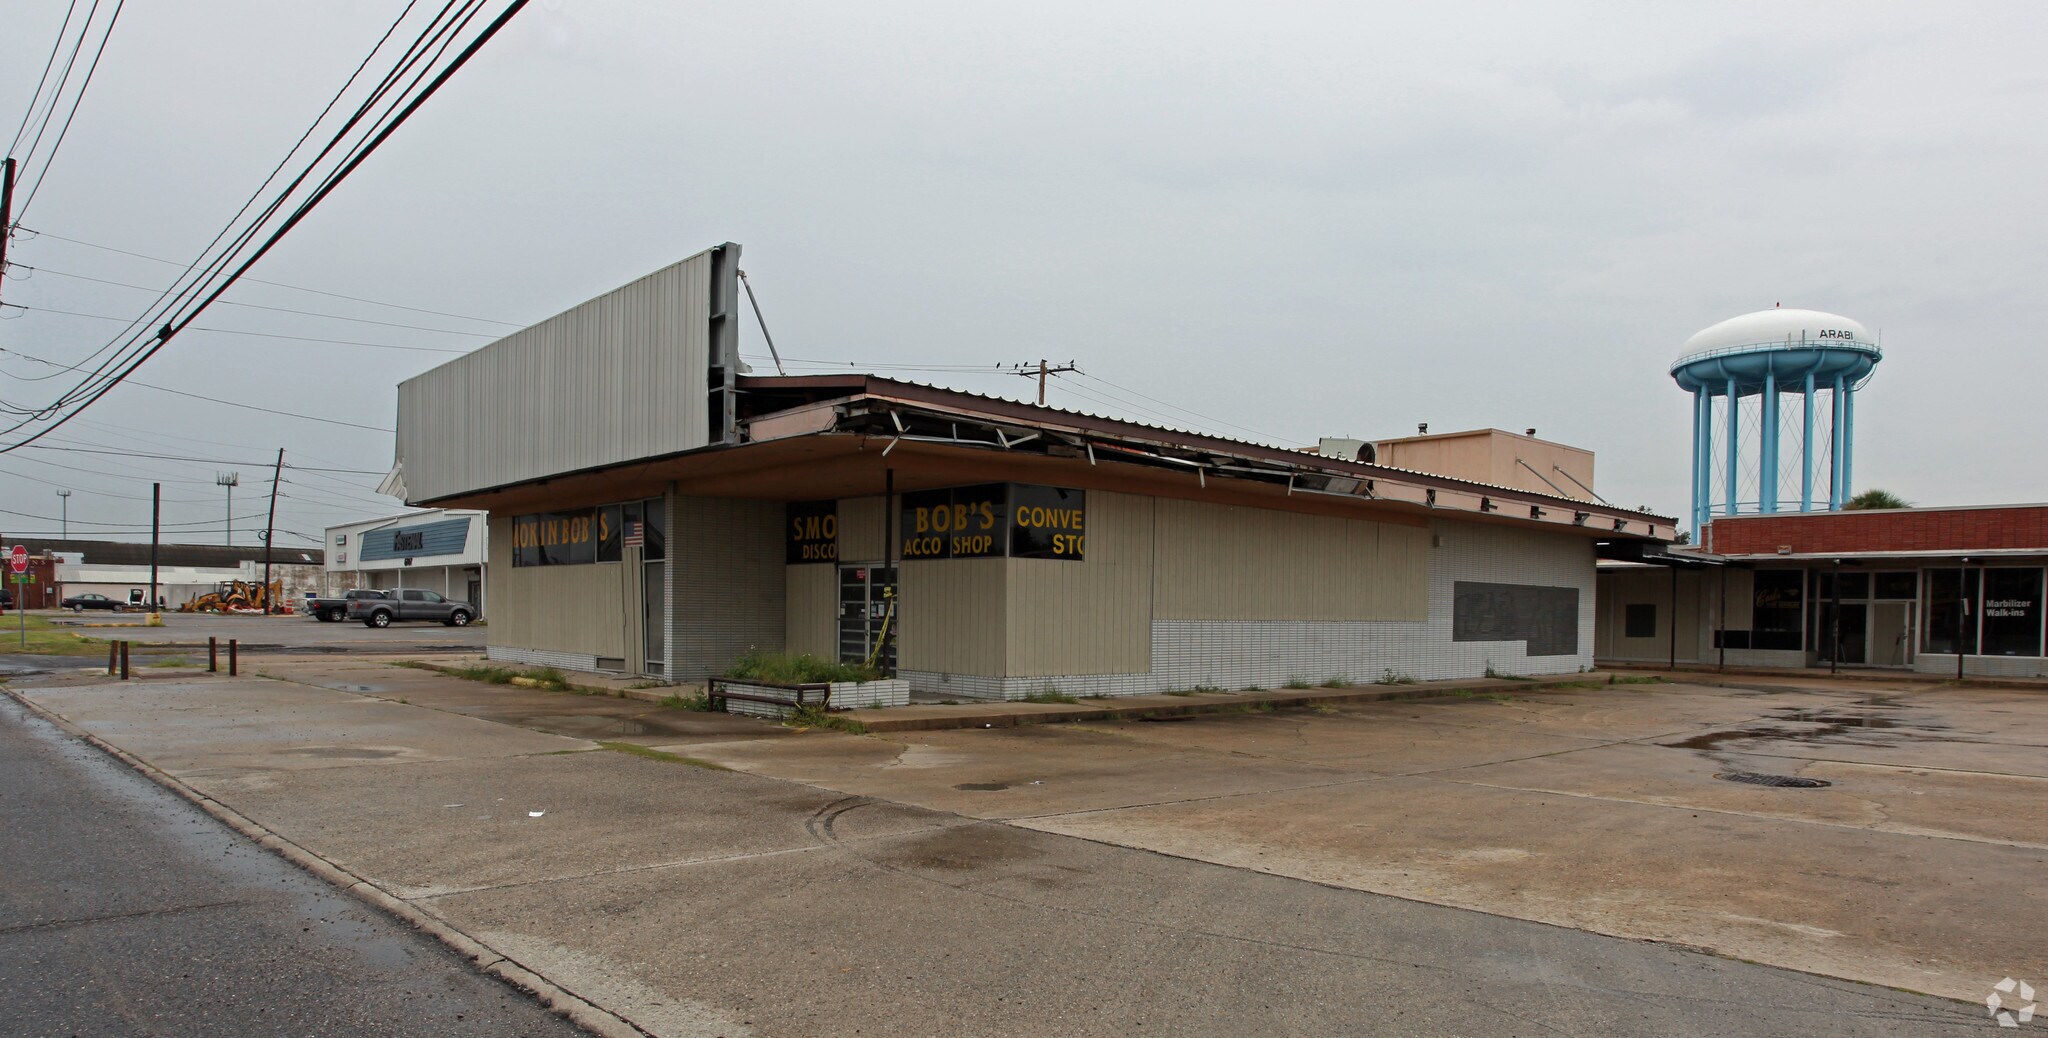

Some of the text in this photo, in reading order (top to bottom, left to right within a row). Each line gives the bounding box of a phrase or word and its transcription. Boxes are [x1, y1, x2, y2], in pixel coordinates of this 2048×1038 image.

[1819, 329, 1853, 340] ARABI
[916, 501, 994, 533] BOB'S
[1016, 505, 1083, 530] CONVE
[561, 512, 609, 545] BOB'S
[793, 514, 837, 541] SMO
[802, 543, 836, 560] DISCO
[903, 535, 992, 556] ACCO SHOP
[12, 553, 28, 565] STOP
[1986, 599, 2032, 608] Marbilizer
[1986, 608, 2026, 617] Walk-ins
